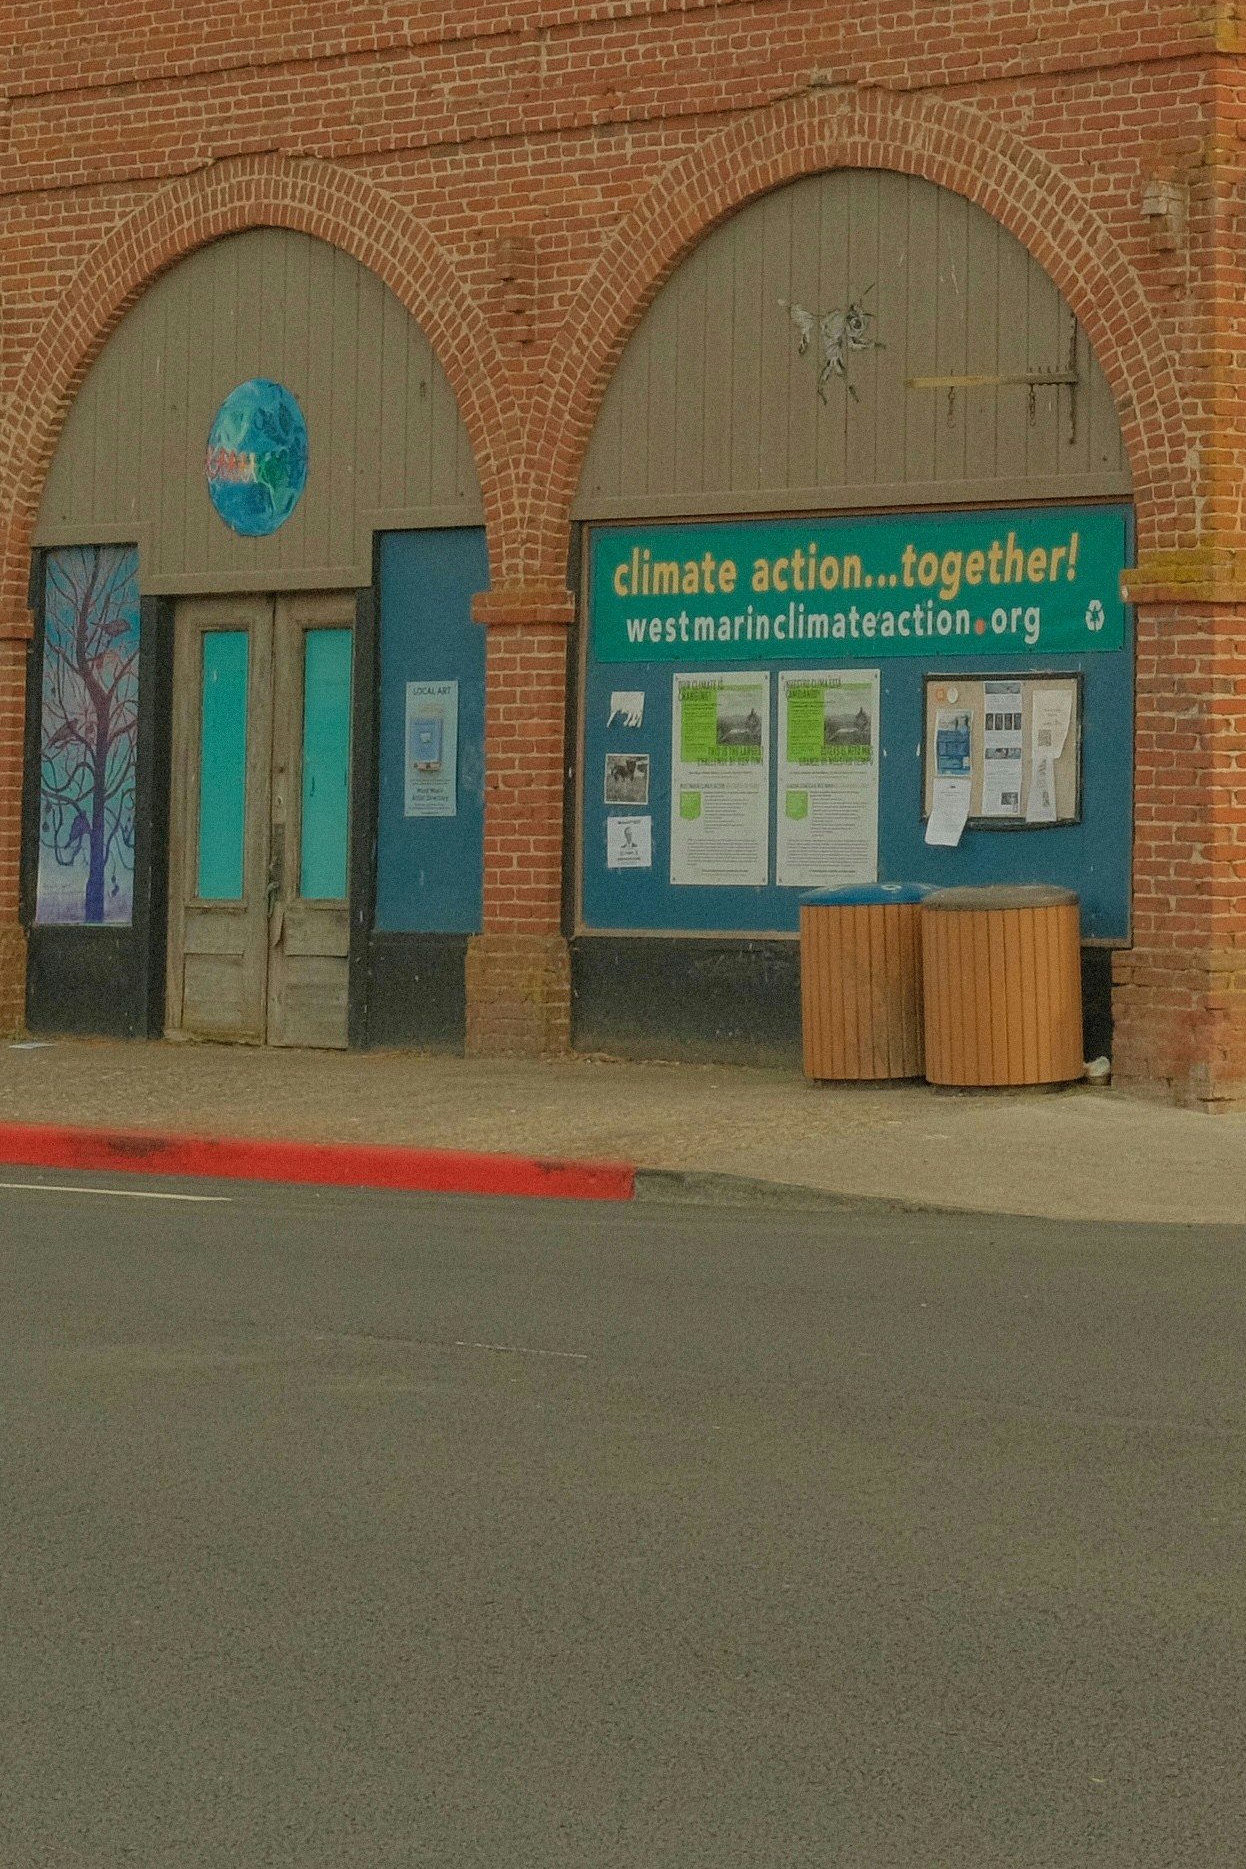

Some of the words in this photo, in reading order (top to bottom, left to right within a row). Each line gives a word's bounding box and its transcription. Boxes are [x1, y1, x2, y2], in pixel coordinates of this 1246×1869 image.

[613, 546, 738, 597] climate
[751, 531, 1080, 601] action...together!
[626, 598, 1041, 644] westmarinclimateaction.org
[412, 687, 436, 696] LOCAL
[437, 686, 451, 695] ART
